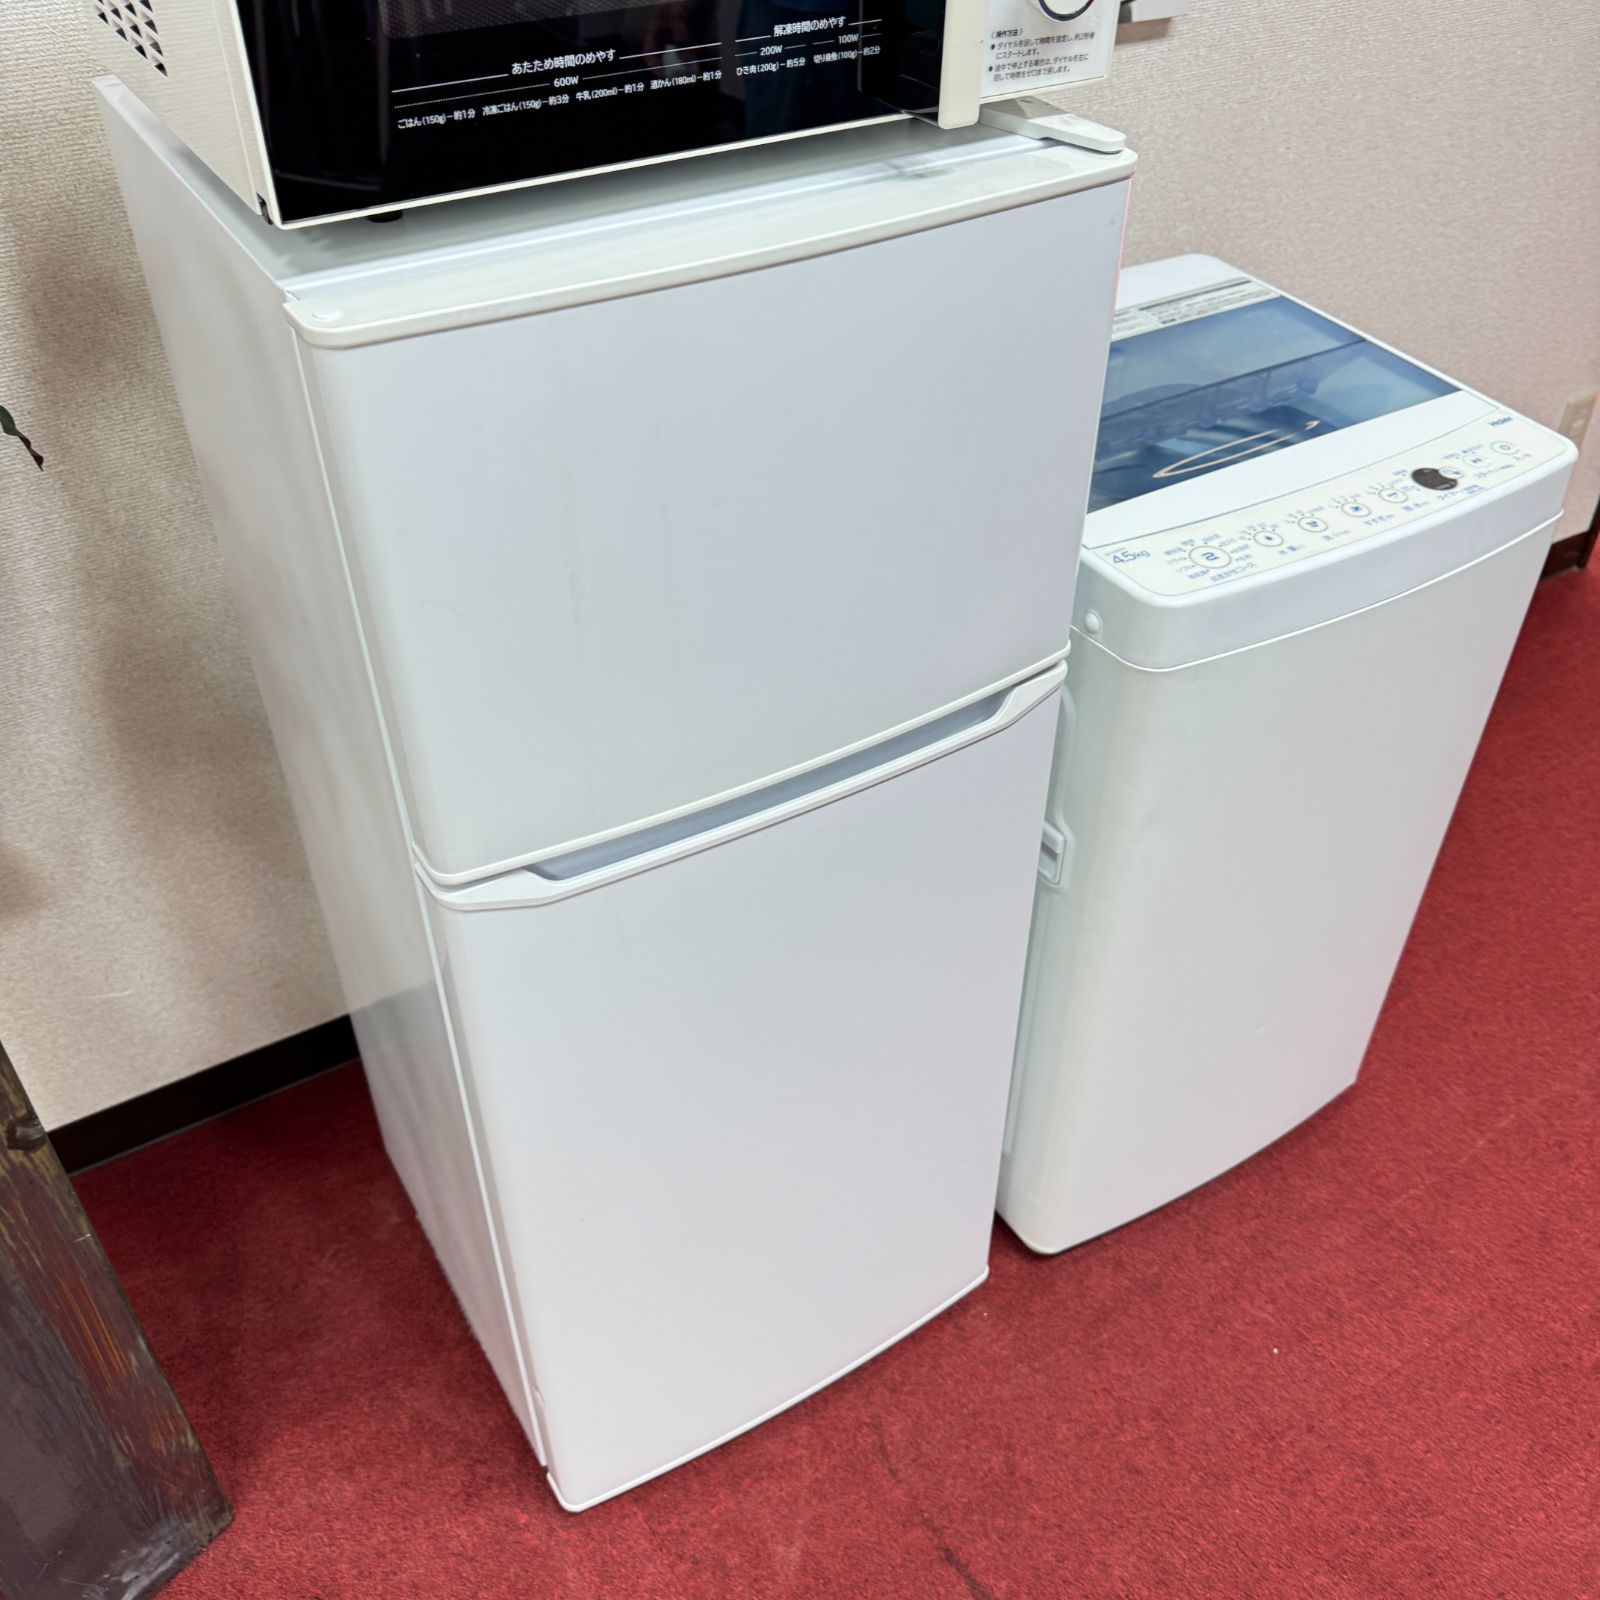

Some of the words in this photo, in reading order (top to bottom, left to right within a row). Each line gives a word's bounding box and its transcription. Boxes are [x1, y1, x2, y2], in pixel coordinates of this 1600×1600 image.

[773, 16, 846, 37] 解凍時間のめやす
[838, 33, 859, 44] 100W
[760, 44, 783, 56] 200W
[511, 48, 616, 75] あたため時間のめやす
[553, 75, 579, 88] 600W
